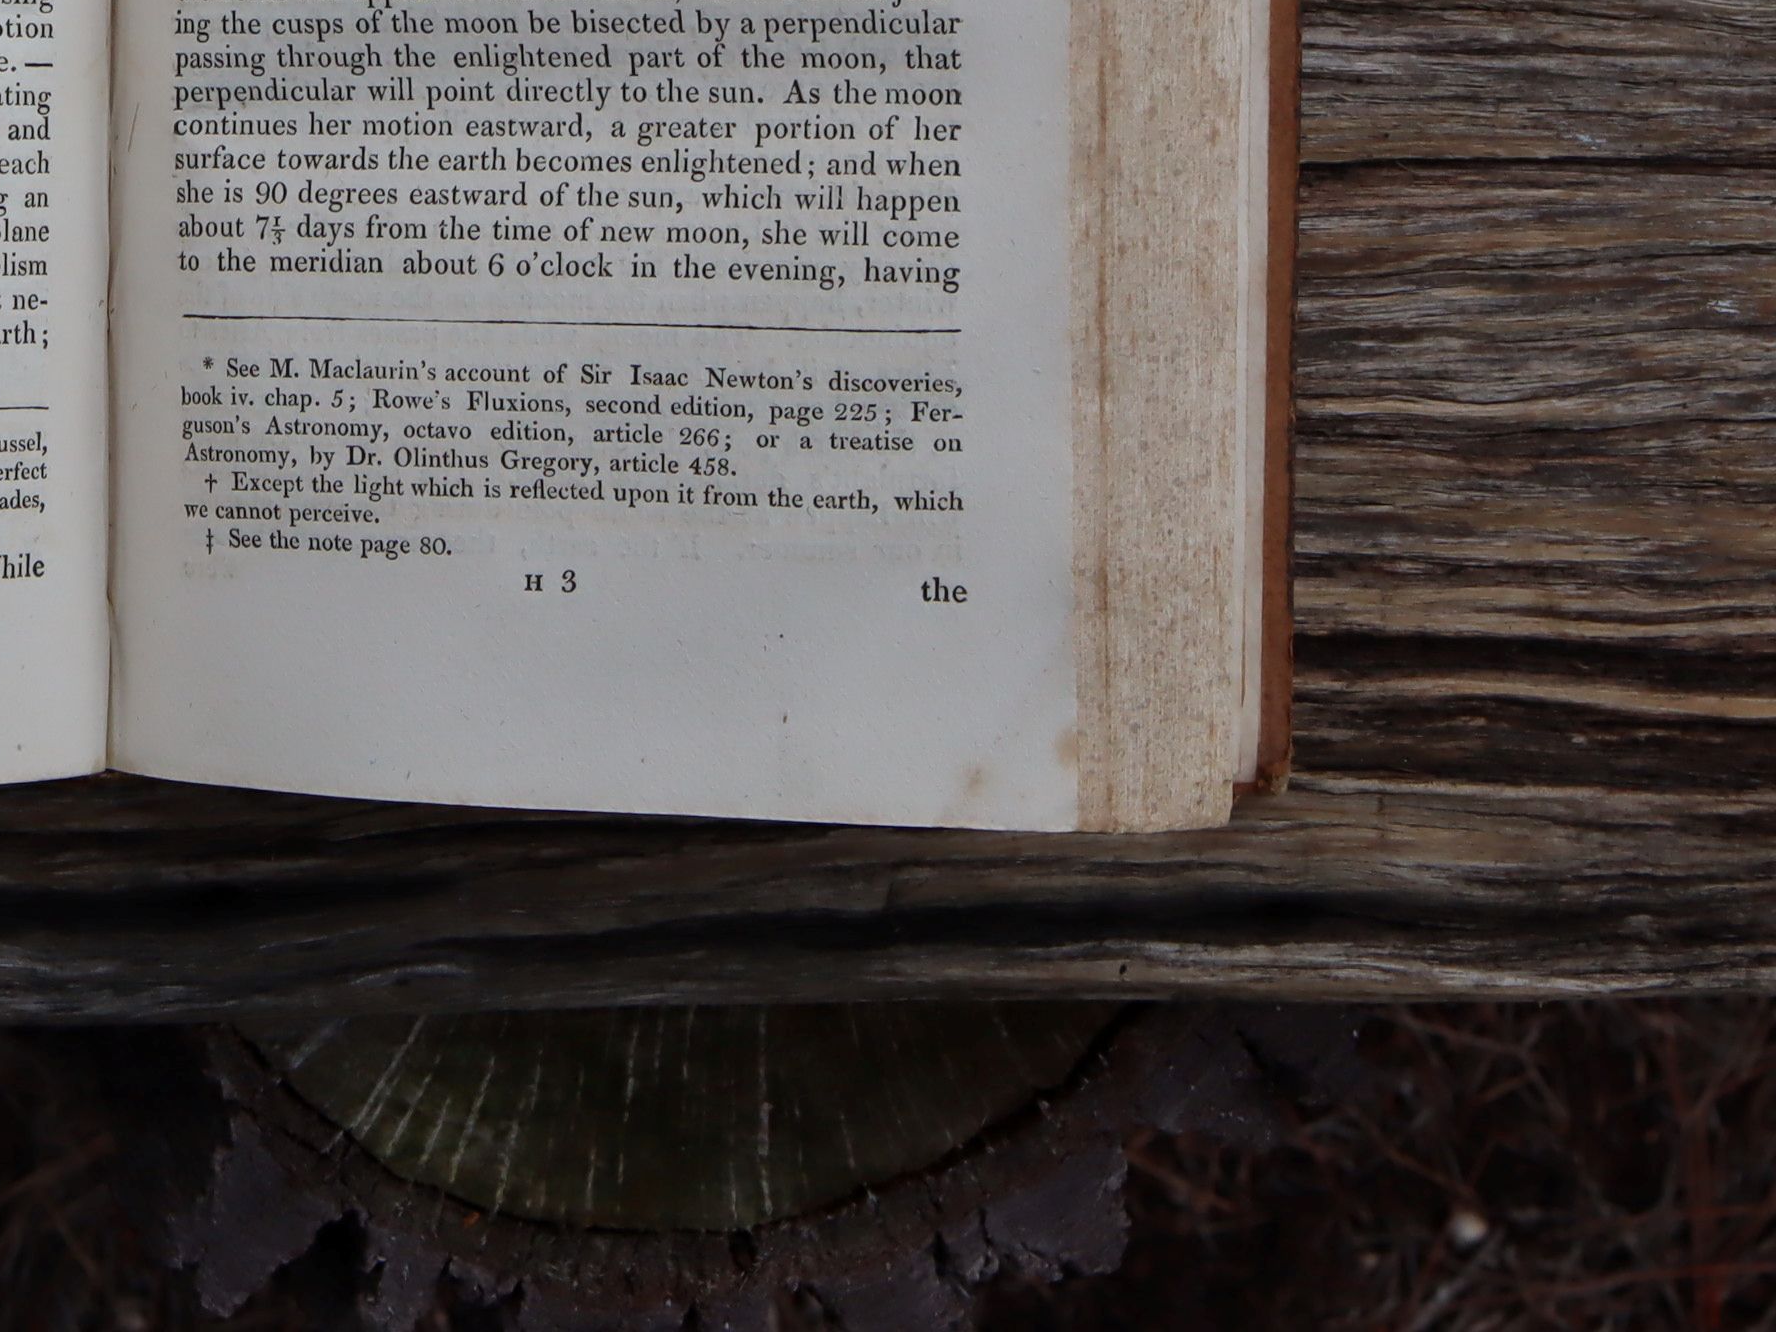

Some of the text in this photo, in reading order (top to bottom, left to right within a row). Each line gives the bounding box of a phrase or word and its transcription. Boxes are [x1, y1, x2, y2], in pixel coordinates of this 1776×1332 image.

[172, 110, 963, 149] continues her motion eastward, a greater portion of her
[264, 414, 390, 445] Astronomy,
[403, 421, 472, 441] octavo
[489, 419, 575, 448] edition,
[592, 421, 664, 445] article
[755, 433, 781, 449] or
[799, 435, 814, 450] a
[828, 429, 915, 452] treatise
[932, 437, 964, 453] on
[183, 441, 737, 478] Astronomy, by Dr. Olinthus Gregory, article 458.
[183, 502, 380, 528] we cannot perceive.
[523, 568, 577, 594] H 3
[920, 576, 969, 604] the
